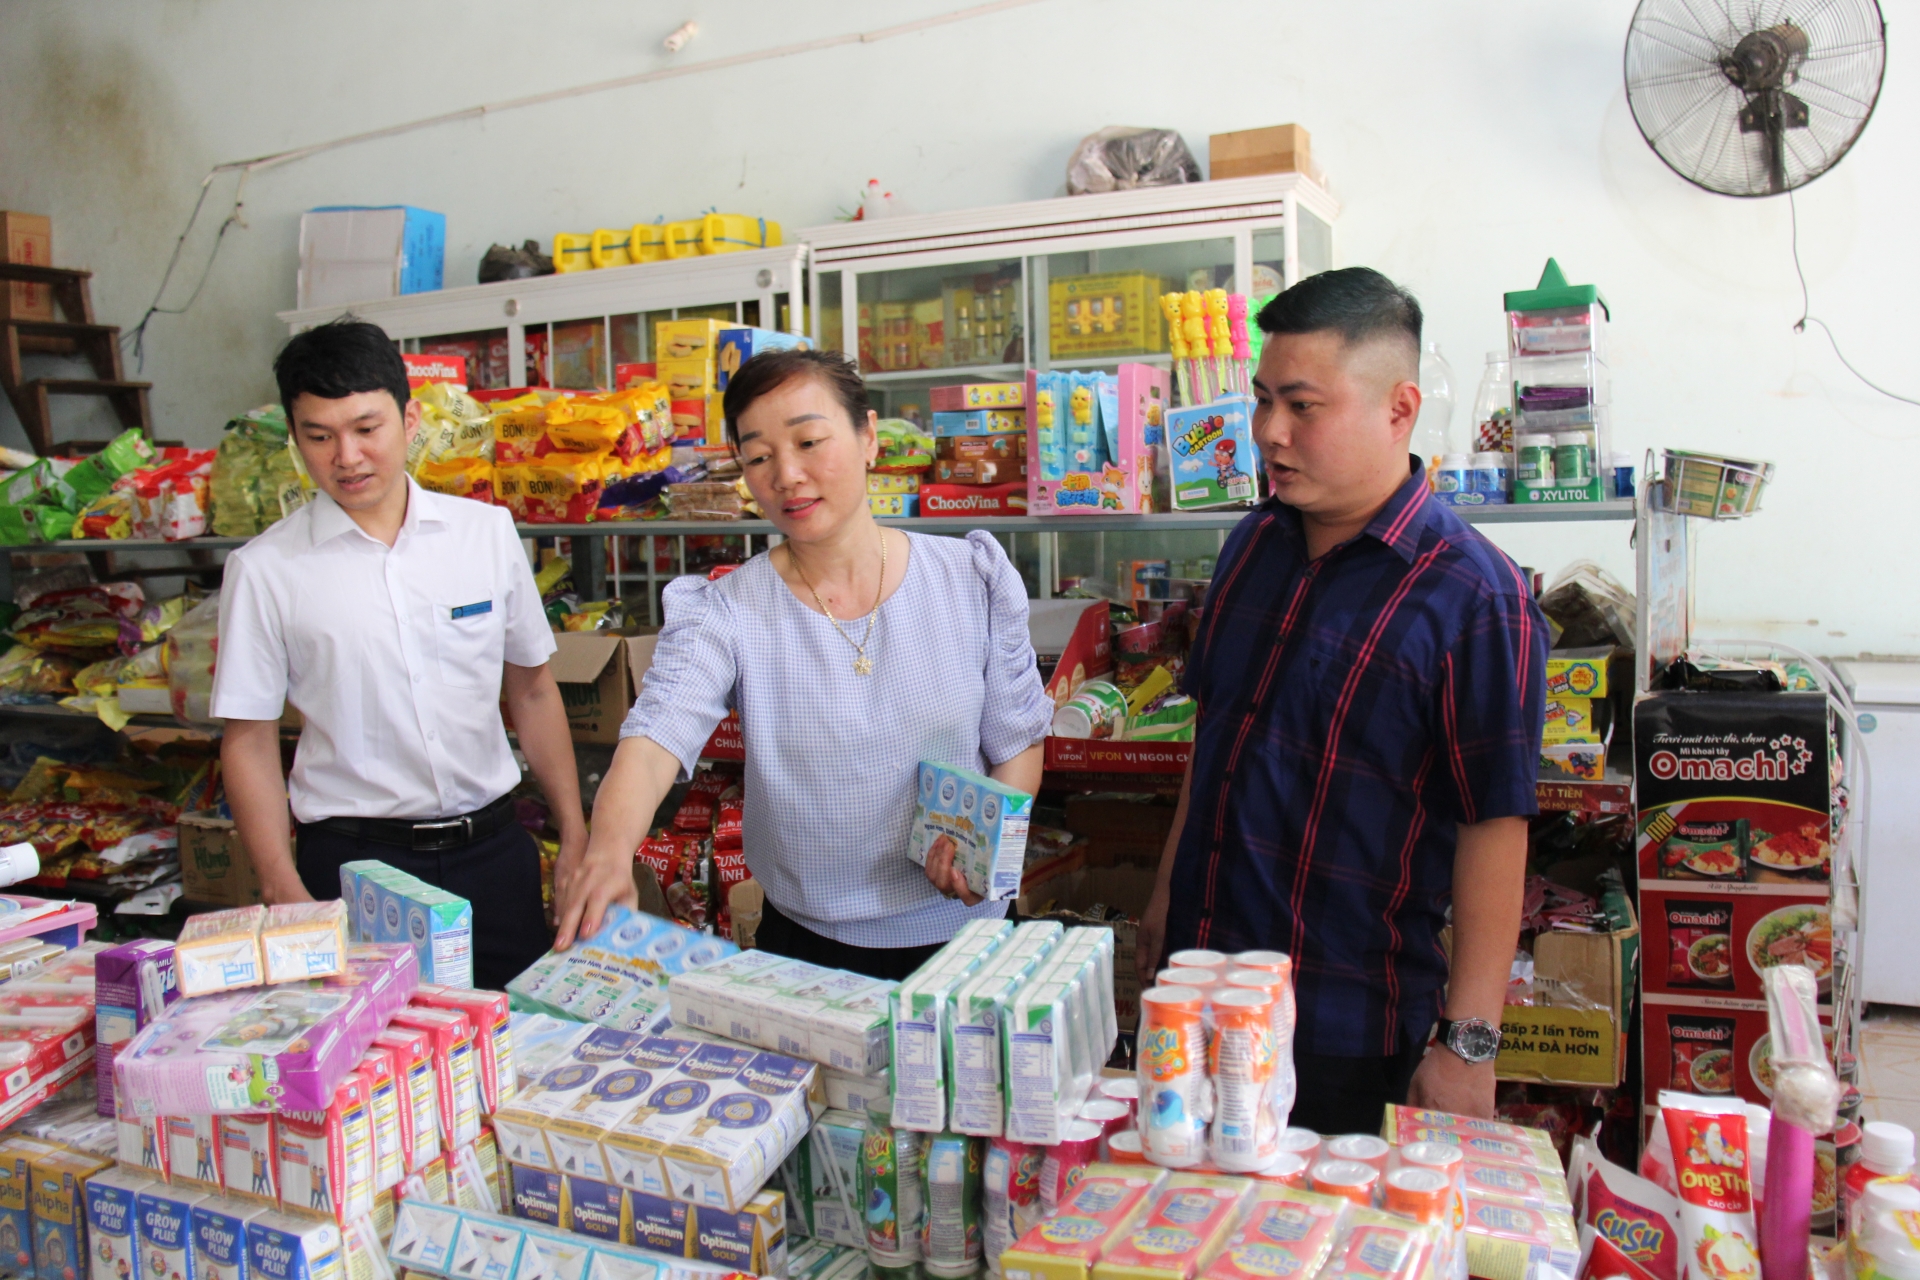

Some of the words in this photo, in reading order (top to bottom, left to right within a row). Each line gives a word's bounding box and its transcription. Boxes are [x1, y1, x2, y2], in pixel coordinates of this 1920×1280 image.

[1172, 415, 1225, 458] Bubble
[1189, 428, 1224, 456] CARTOON
[927, 495, 1000, 511] ChocoVina
[1542, 489, 1590, 501] XYLITOL
[1057, 753, 1083, 761] VIFON
[1089, 751, 1122, 761] VIFON
[1124, 752, 1137, 763] VỊ
[1139, 753, 1173, 762] NGON
[1680, 747, 1691, 755] Mì
[1691, 747, 1715, 755] khoai
[1716, 747, 1730, 756] tây
[1649, 749, 1789, 781] Omachi
[1557, 785, 1583, 798] TIỀN
[1679, 824, 1723, 836] Omachi
[1669, 911, 1721, 926] Omachi
[1500, 1022, 1527, 1036] Gấp
[1531, 1025, 1539, 1035] 2
[1568, 1026, 1599, 1039] Tôm
[1671, 1025, 1724, 1041] Omachi
[630, 1045, 680, 1065] Optimum
[1538, 1040, 1561, 1054] ĐÀ
[1565, 1042, 1599, 1056] HƠN
[685, 1059, 738, 1075] Optimum
[742, 1068, 798, 1089] Optimum
[1681, 1168, 1724, 1197] Ông
[525, 1189, 548, 1198] VINAMILK
[33, 1191, 70, 1215] Alpha
[93, 1200, 126, 1218] GROW
[516, 1194, 558, 1213] Optimum
[583, 1201, 606, 1211] VINAMILK
[1708, 1199, 1726, 1209] CAO
[146, 1212, 181, 1231] GROW
[527, 1208, 549, 1220] GOLD
[574, 1207, 619, 1226] Optimum
[646, 1215, 671, 1225] VINAMILK
[100, 1215, 122, 1230] PLUS
[585, 1221, 608, 1233] GOLD
[636, 1220, 684, 1241] Optimum
[152, 1226, 176, 1243] PLUS
[201, 1226, 235, 1246] GROW
[710, 1228, 737, 1238] VINAMILK
[1595, 1208, 1664, 1254] SuSu
[647, 1235, 672, 1247] GOLD
[700, 1232, 750, 1254] Optimum
[207, 1242, 230, 1260] PLUS
[255, 1242, 292, 1265] GROW
[711, 1249, 738, 1261] GOLD
[262, 1258, 287, 1277] PLUS
